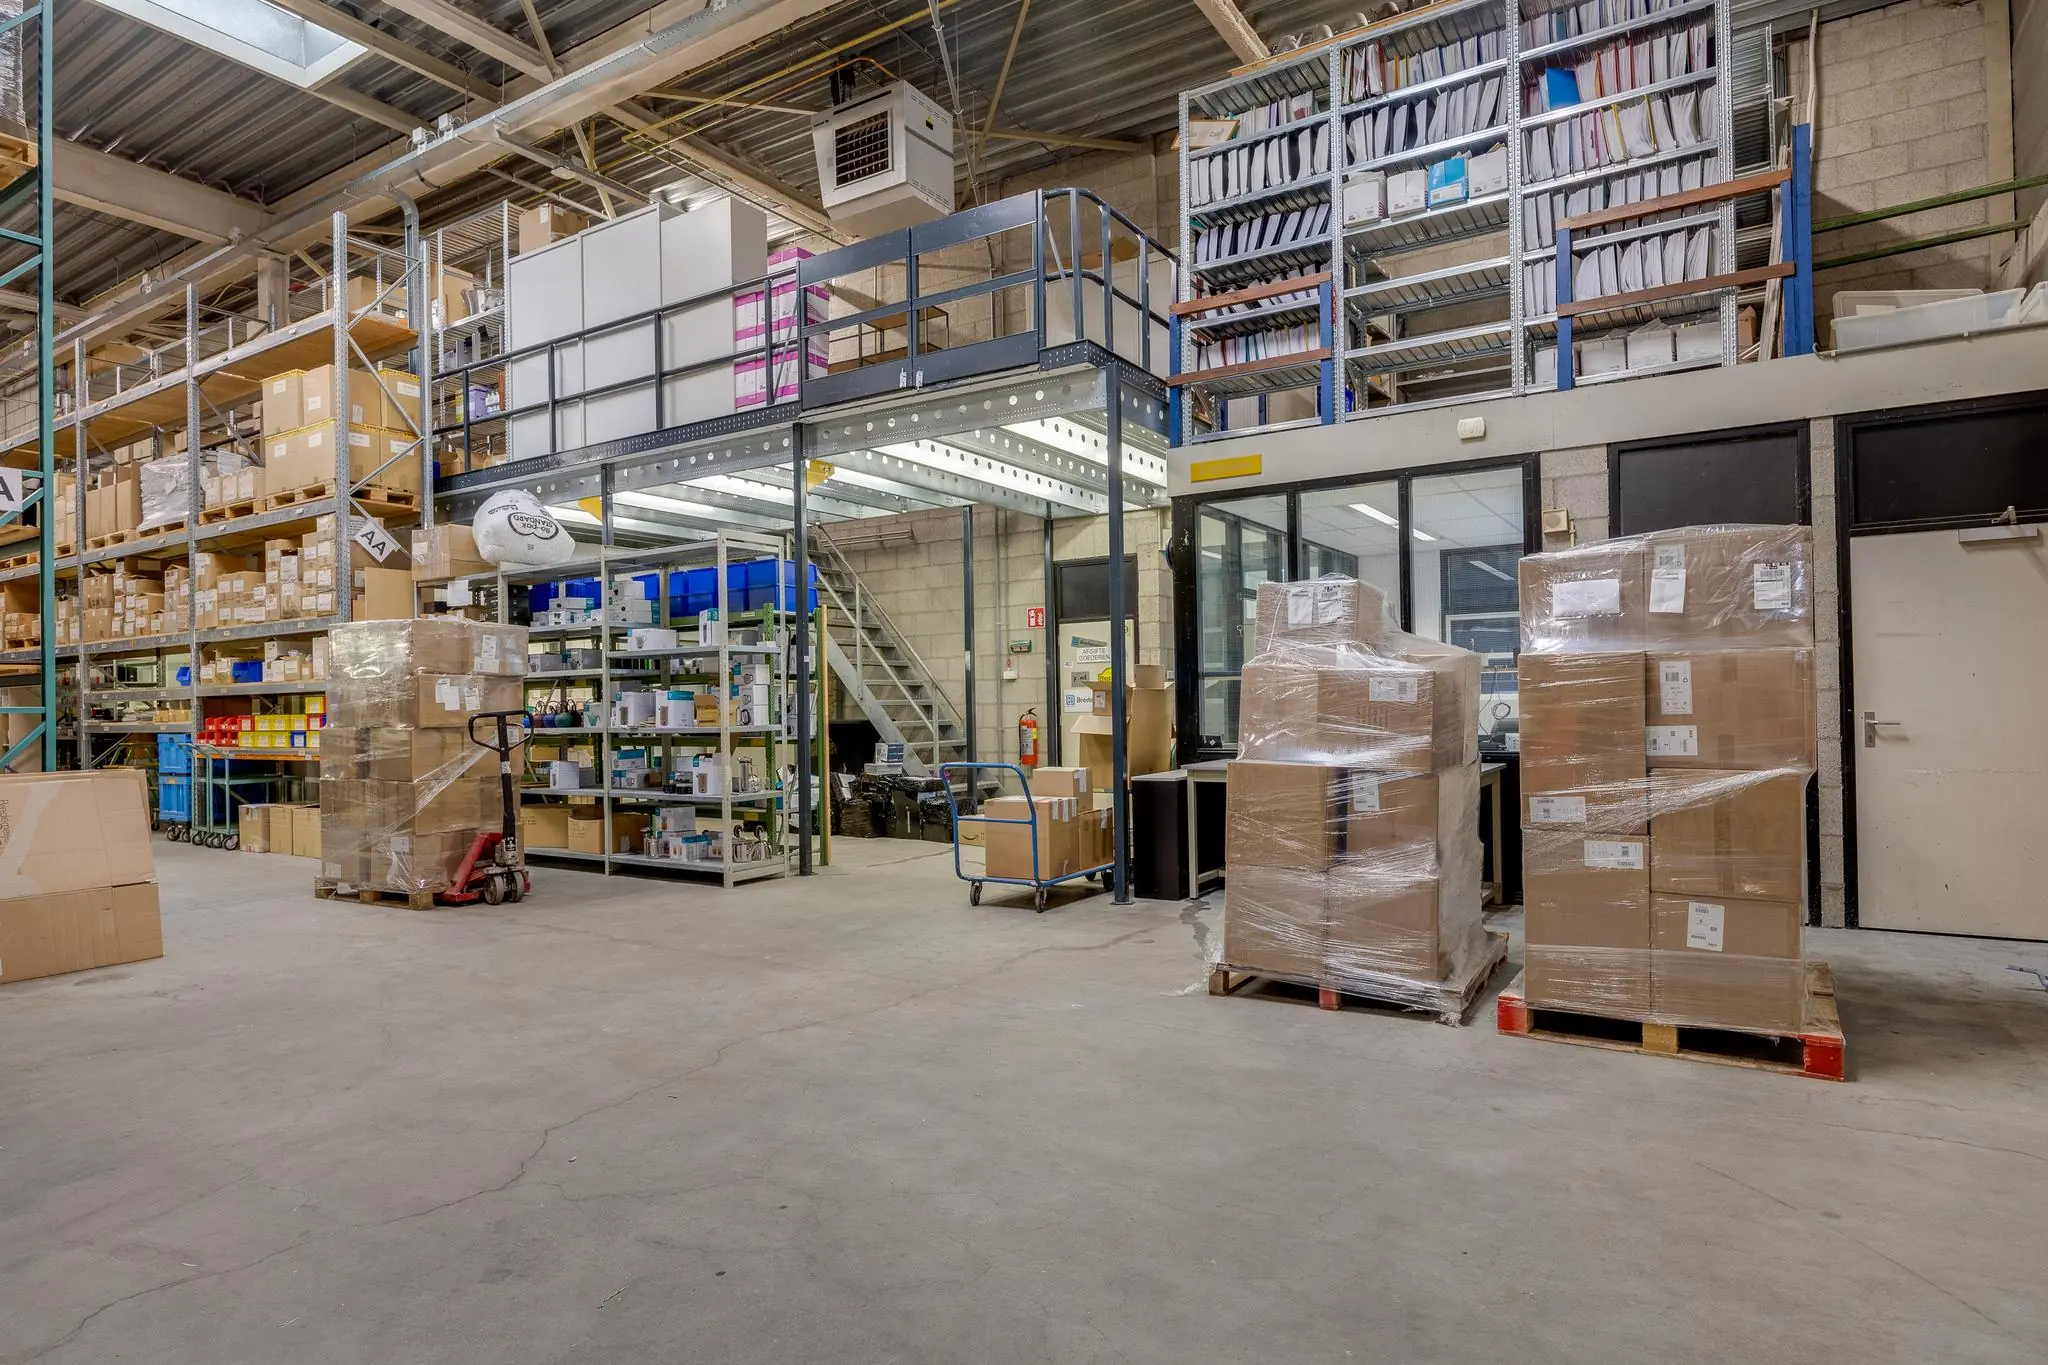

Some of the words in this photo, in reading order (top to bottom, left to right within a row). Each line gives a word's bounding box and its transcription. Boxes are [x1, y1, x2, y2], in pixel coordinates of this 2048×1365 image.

[513, 514, 553, 528] STANDARD
[360, 530, 386, 556] AA
[1078, 654, 1110, 662] GOEDEREN
